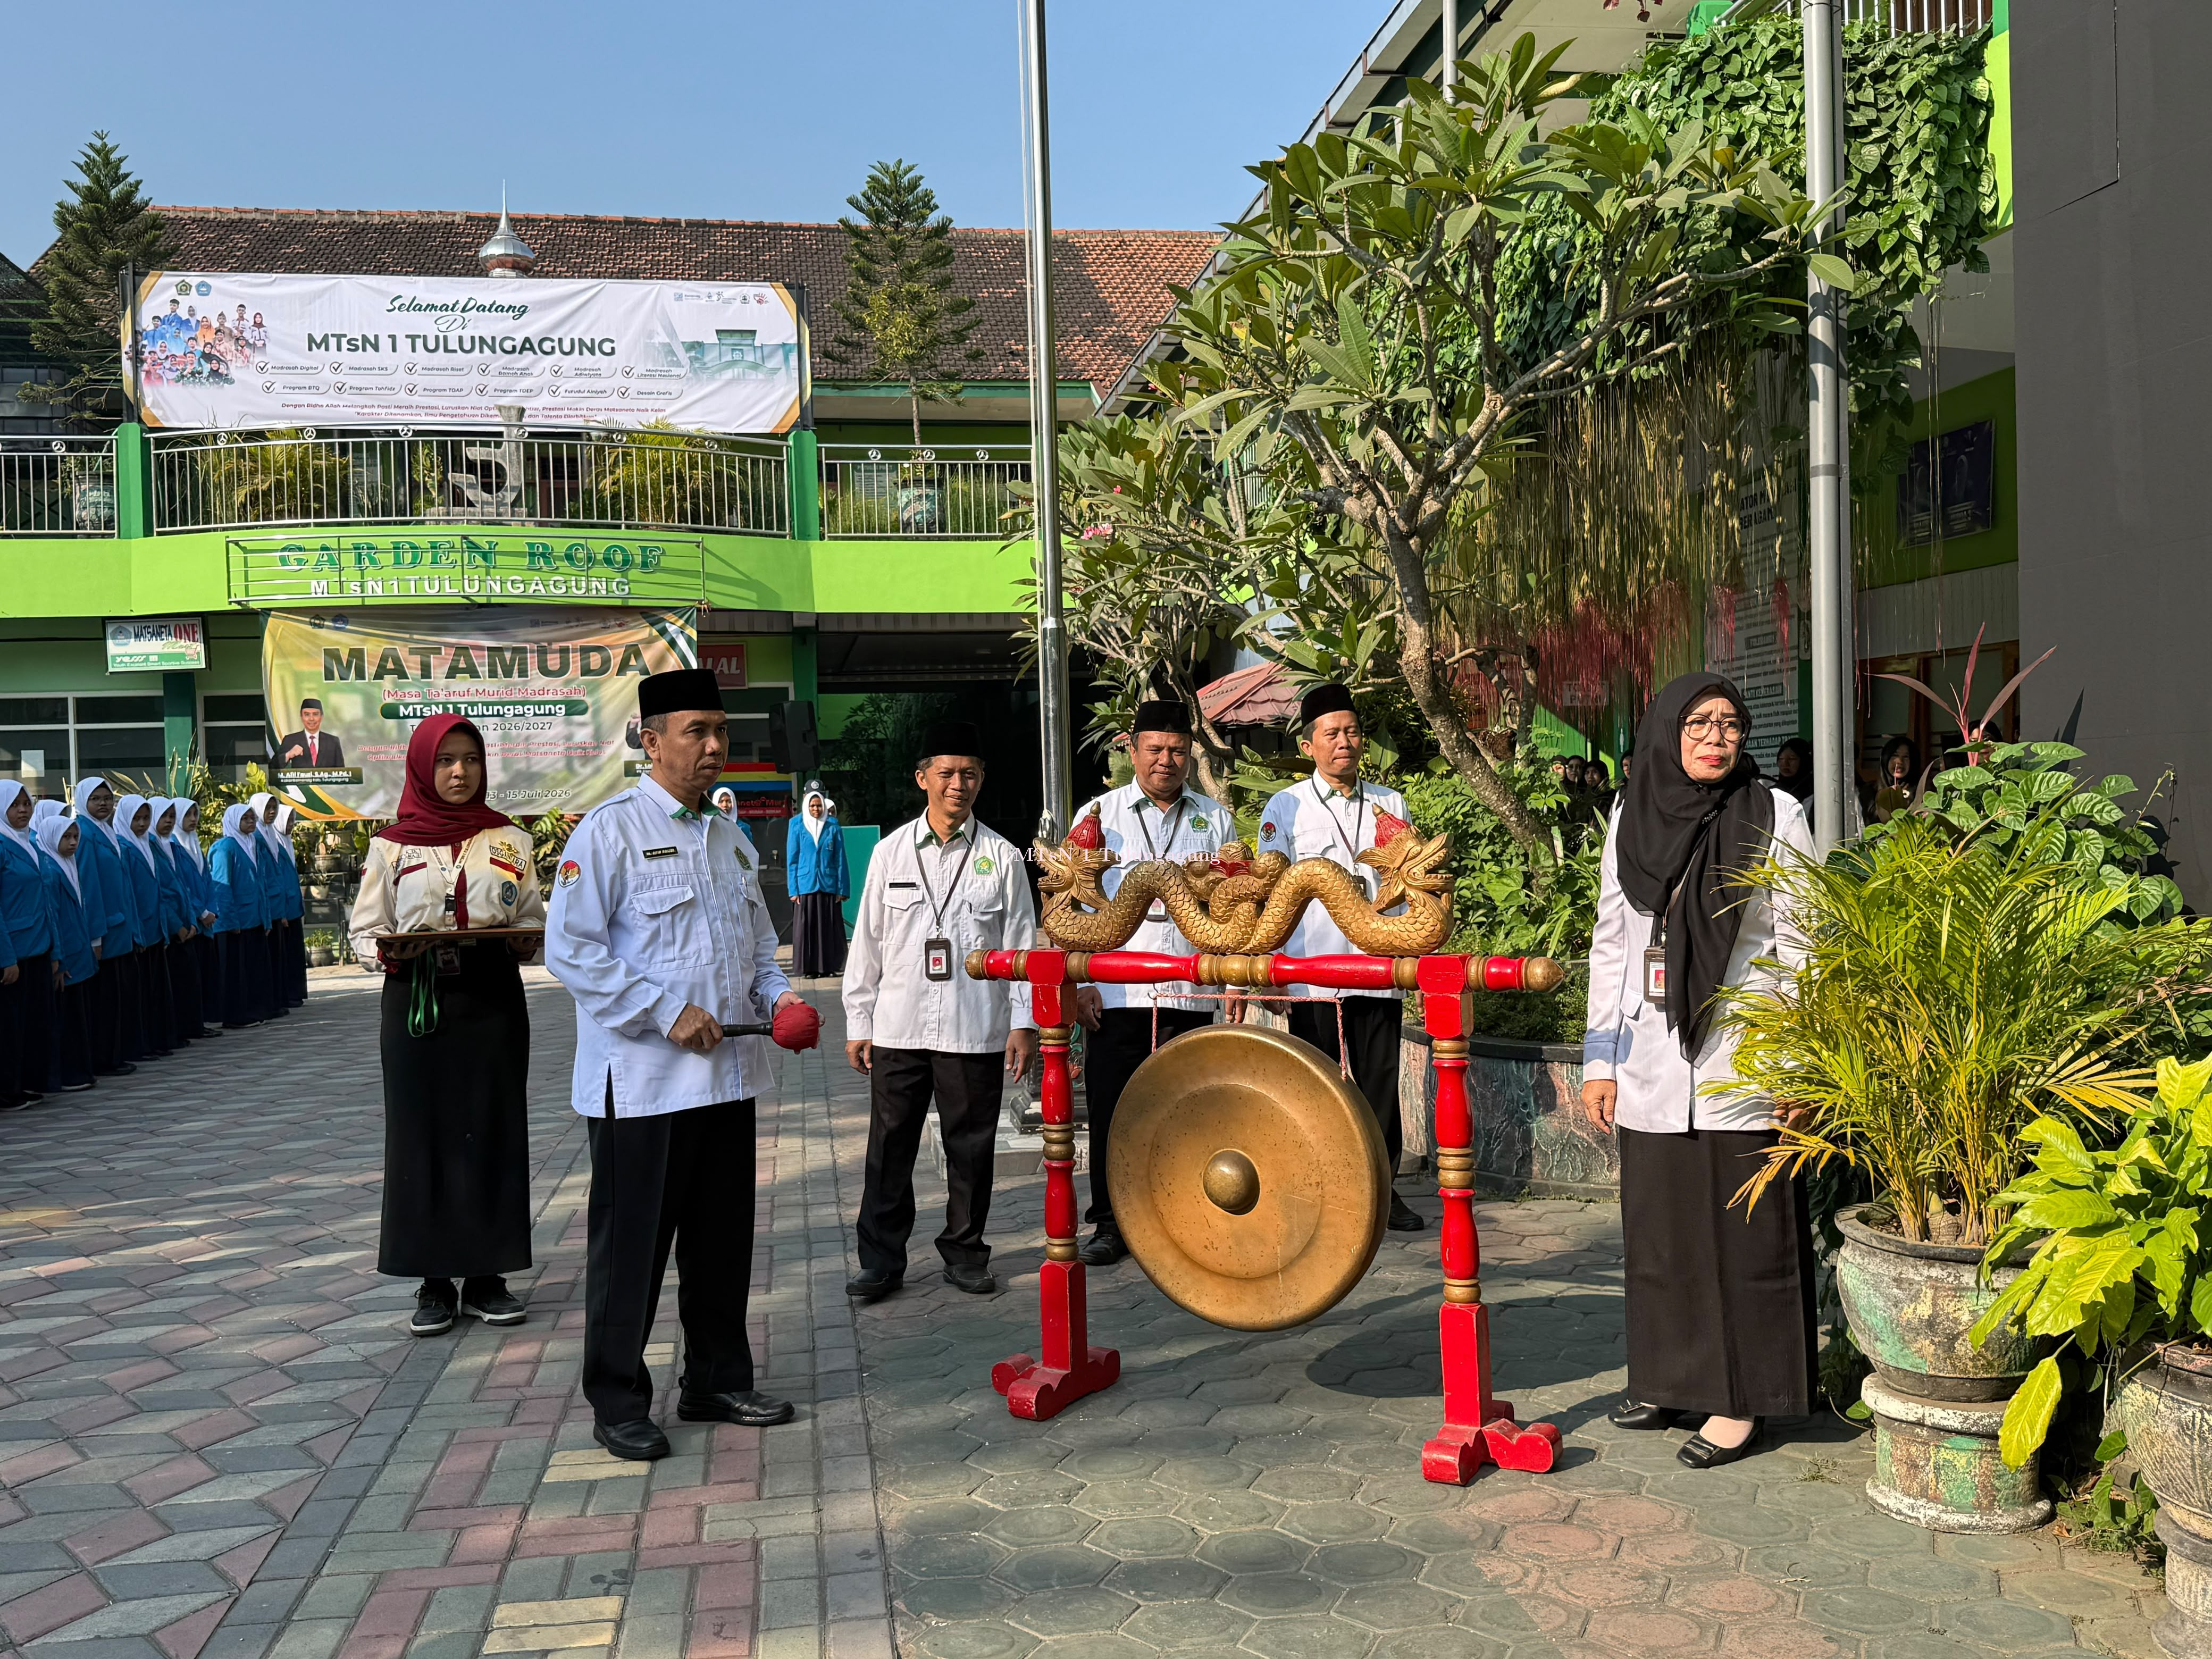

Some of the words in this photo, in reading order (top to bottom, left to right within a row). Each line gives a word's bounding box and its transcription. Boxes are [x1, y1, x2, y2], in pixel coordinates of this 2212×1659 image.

[386, 295, 460, 313] Selamat
[460, 297, 530, 320] Datang
[434, 314, 472, 332] Di
[307, 333, 380, 353] MTsN
[388, 334, 397, 353] 1
[405, 334, 616, 356] TULUNGAGUNG
[278, 540, 498, 572] GARDEN
[524, 541, 664, 572] ROOF
[133, 624, 173, 642] MATSANETA
[173, 623, 199, 643] ONE
[322, 643, 652, 683] MATAMUDA
[383, 688, 422, 701] (Masa
[426, 688, 472, 699] Ta'aruf
[475, 686, 514, 698] Murid
[517, 685, 586, 698] Madrasah)
[399, 705, 443, 717] MTsN
[448, 705, 453, 714] 1
[457, 703, 565, 717] Tulungagung
[492, 722, 552, 732] 2026/2027
[507, 790, 518, 799] 15
[521, 790, 542, 799] Juli
[543, 789, 571, 798] 2026
